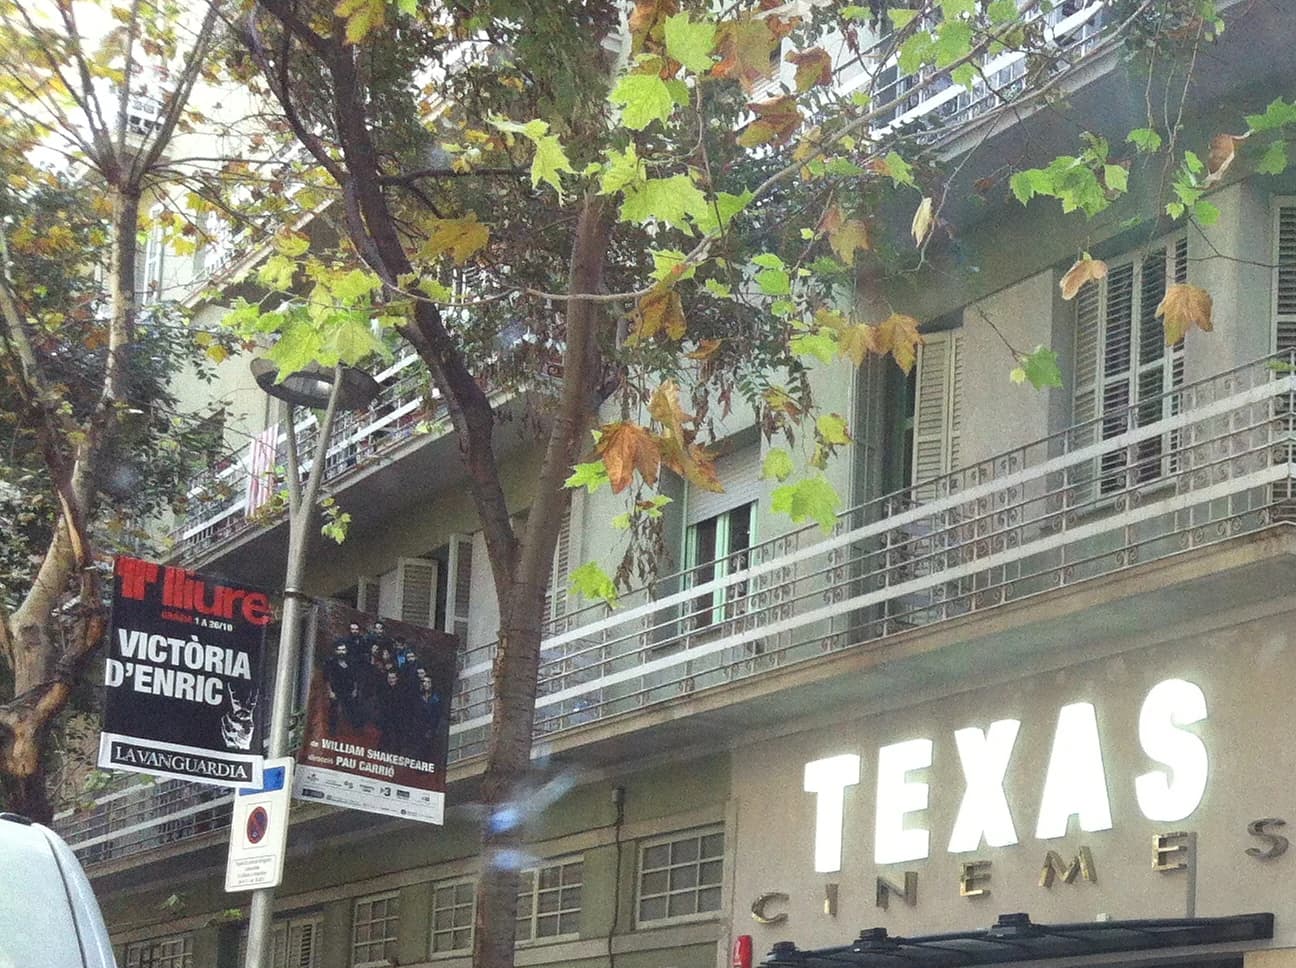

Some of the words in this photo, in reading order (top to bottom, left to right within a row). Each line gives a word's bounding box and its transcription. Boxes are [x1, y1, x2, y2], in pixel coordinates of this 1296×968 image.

[118, 628, 252, 680] VICTÒRIA
[104, 658, 224, 706] D'ENRIC
[115, 745, 137, 763] LA
[135, 749, 249, 780] VANGUARDIA
[321, 738, 365, 757] WILLIAM
[367, 749, 436, 774] SHAKESPEARE
[335, 756, 357, 769] PAU
[358, 761, 395, 778] CARRIÓ
[803, 678, 1210, 873] TEXAS
[751, 816, 1291, 926] CINEMES
